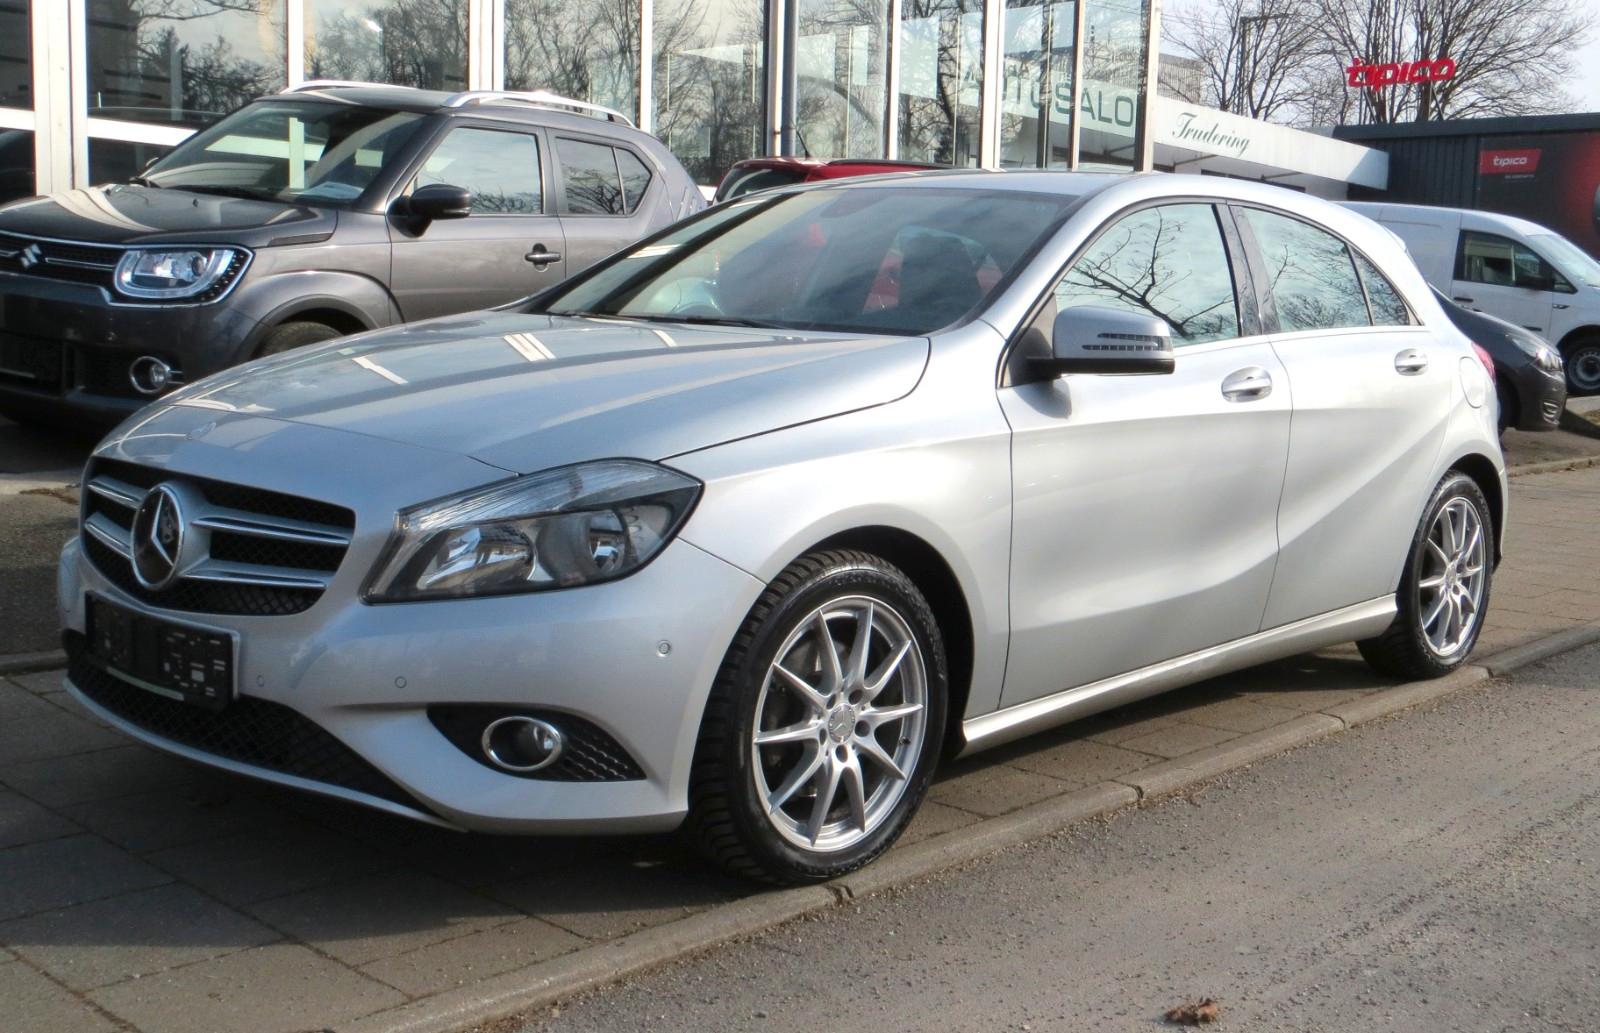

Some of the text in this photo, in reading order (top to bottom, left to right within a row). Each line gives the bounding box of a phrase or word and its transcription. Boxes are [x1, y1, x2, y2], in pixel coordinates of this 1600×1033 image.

[1346, 57, 1456, 93] tipico
[1172, 112, 1250, 157] Trudering
[1493, 156, 1528, 167] tipico
